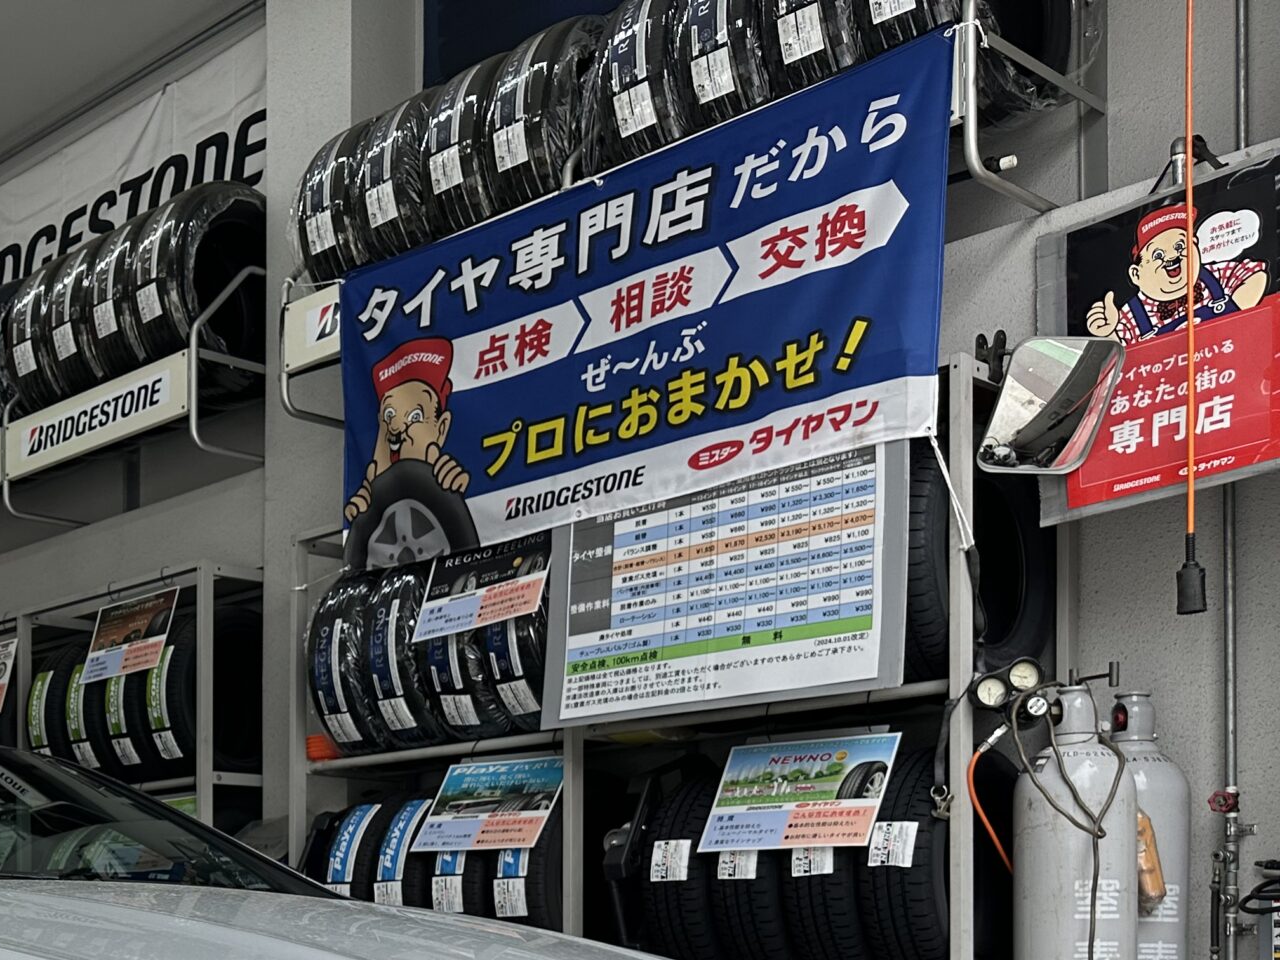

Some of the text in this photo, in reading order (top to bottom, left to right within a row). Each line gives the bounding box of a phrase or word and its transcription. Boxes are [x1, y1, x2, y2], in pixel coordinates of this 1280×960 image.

[358, 94, 907, 341] タイヤ専門店 だから
[1141, 212, 1193, 234] BRIDGESTO
[473, 204, 868, 379] 点検 相談 交換
[378, 351, 445, 382] BRIDGESTONE
[1110, 366, 1235, 416] あなたの街の
[27, 378, 162, 457] BRIDGESTONE
[1108, 394, 1235, 454] 専門店
[504, 397, 880, 522] BRIDGESTONE ミスター タイヤマン
[445, 549, 492, 568] REGNO
[572, 545, 612, 562] タイヤ整備
[769, 752, 832, 766] NEWNO
[334, 824, 353, 871] Playz
[384, 820, 404, 868] Playz
